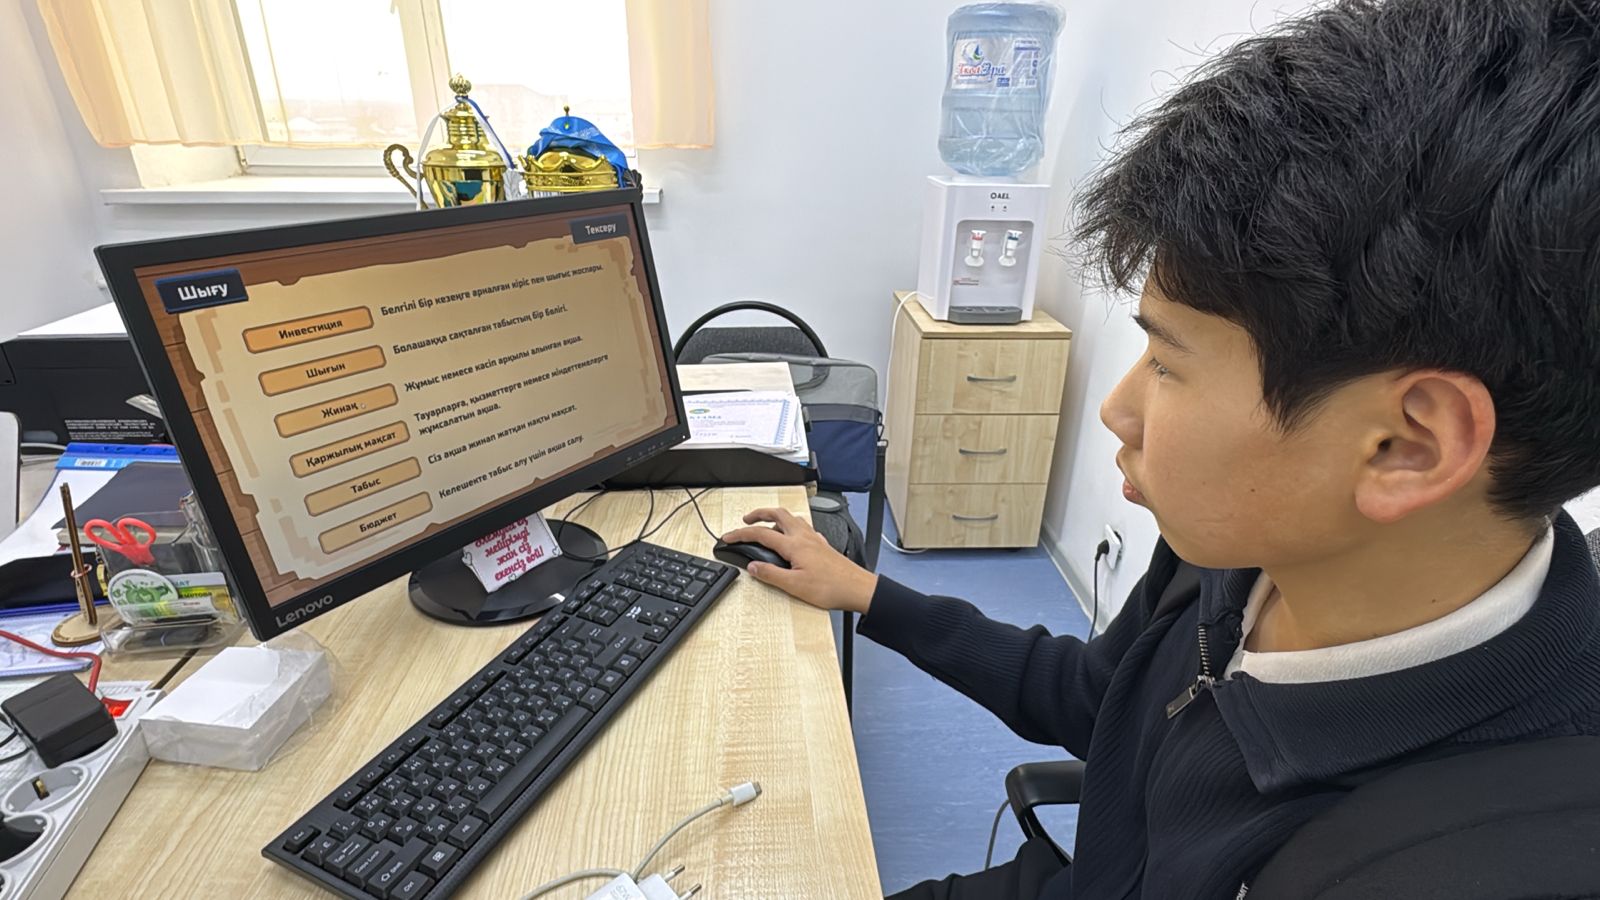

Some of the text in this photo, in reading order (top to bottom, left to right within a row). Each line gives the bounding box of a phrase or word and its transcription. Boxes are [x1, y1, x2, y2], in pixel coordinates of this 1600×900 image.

[585, 223, 617, 235] Тексеру
[177, 283, 228, 301] Шығу
[380, 299, 417, 316] Белгілі
[418, 297, 434, 309] бір
[435, 290, 471, 305] кезеңге
[472, 282, 511, 298] арналған
[512, 278, 530, 289] кіріс
[531, 275, 546, 285] пен
[546, 270, 571, 281] шығыс
[279, 319, 343, 340] Инвестиция
[392, 335, 448, 355] Болашаққа
[449, 324, 492, 341] сақталған
[493, 314, 532, 330] табыстың
[532, 310, 544, 320] бір
[305, 362, 347, 379] Шығын
[404, 376, 441, 392] Жұмыс
[441, 366, 474, 381] немесе
[498, 350, 530, 366] арқылы
[320, 401, 359, 419] Жинақ
[414, 399, 469, 422] Тауарларға,
[469, 382, 523, 405] қызметтерге
[523, 372, 551, 387] немесе
[418, 402, 501, 435] жұмсалатын ақша.
[305, 431, 397, 467] Қаржылық мақсат
[427, 453, 442, 464] Сіз
[444, 444, 468, 459] ақша
[468, 433, 497, 451] жинап
[497, 423, 527, 439] жатқан
[527, 413, 551, 427] нақты
[350, 478, 382, 494] Табыс
[439, 473, 488, 499] Келешекте
[488, 463, 513, 479] табыс
[514, 456, 528, 466] алу
[528, 449, 547, 463] үшін
[547, 441, 567, 454] ақша
[359, 511, 398, 533] Бюджет
[496, 541, 532, 566] жан сіз
[275, 593, 334, 628] Lenovo
